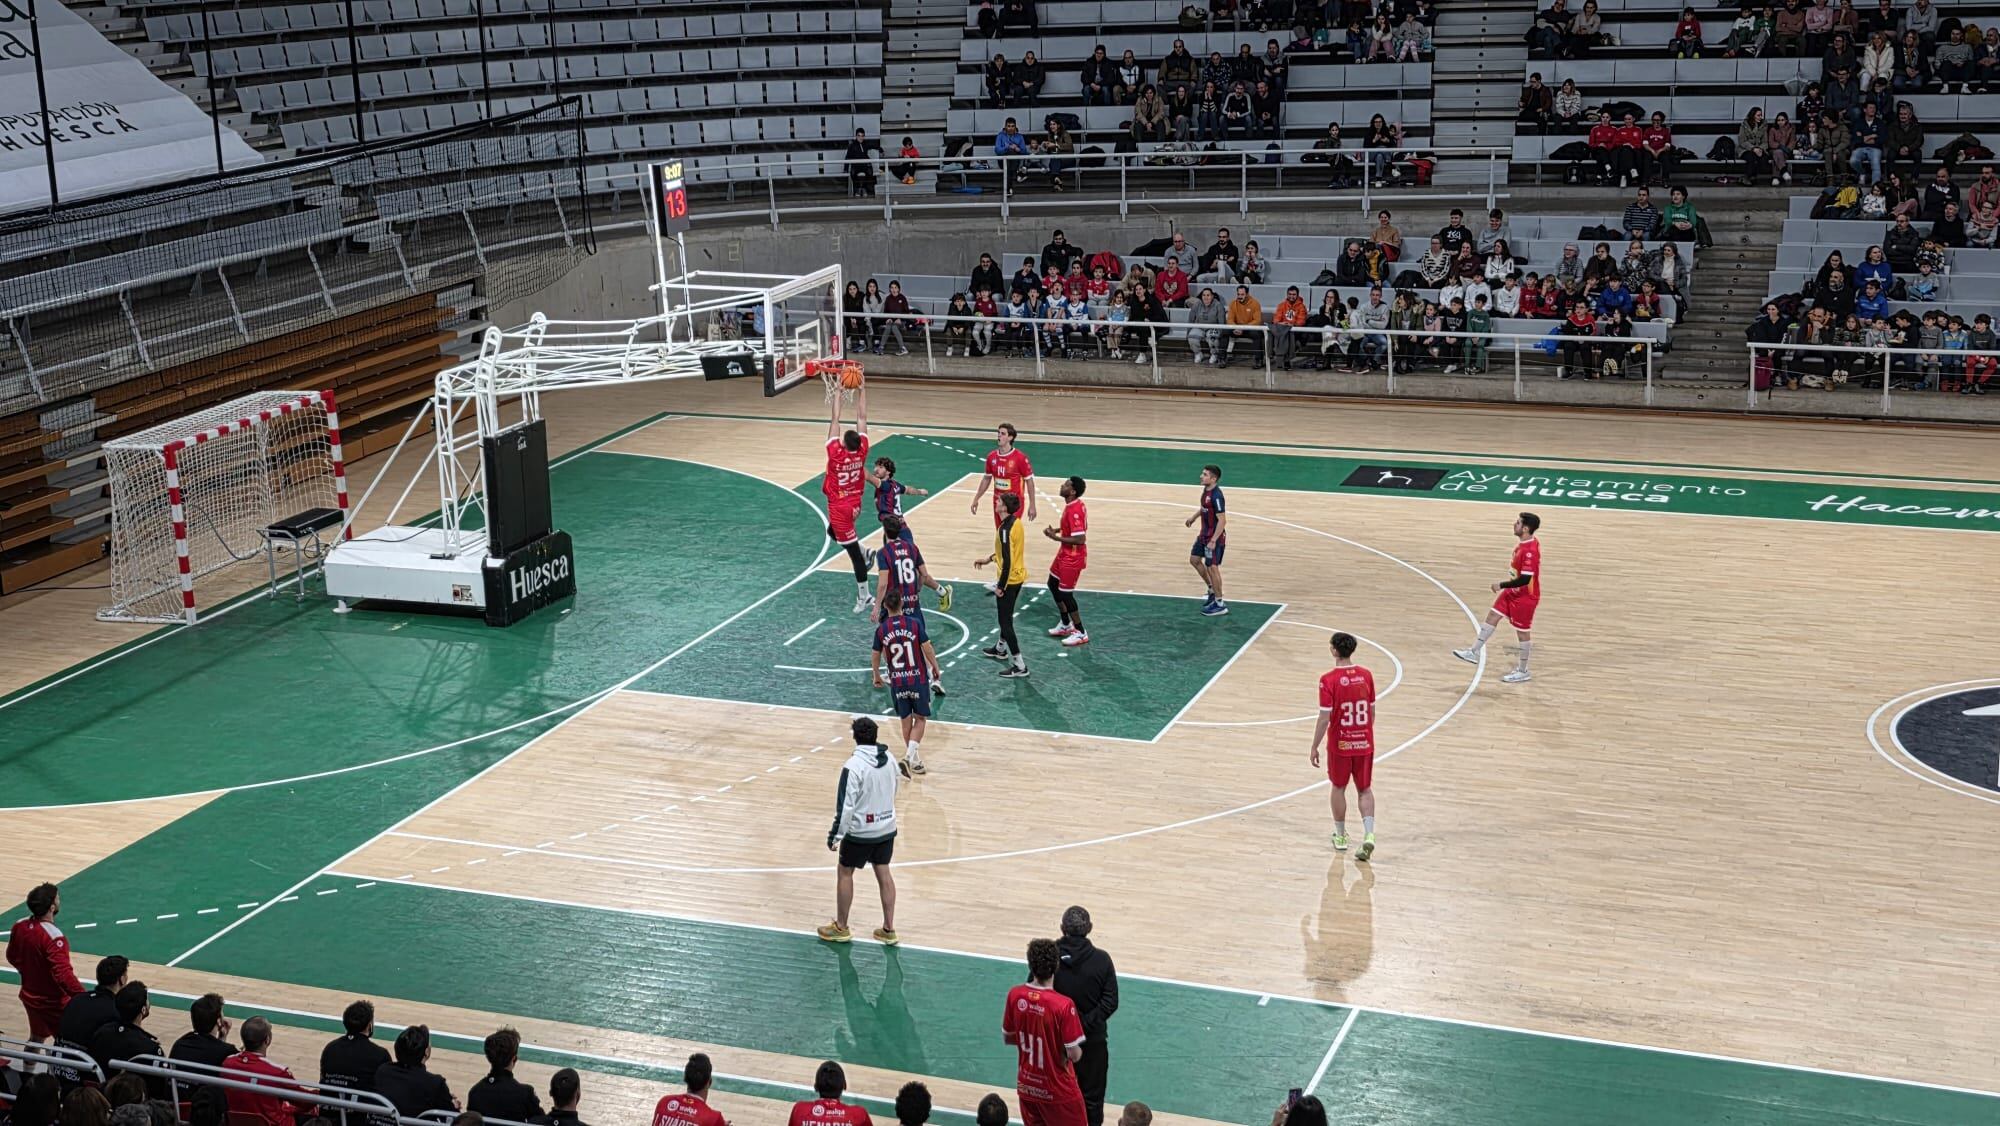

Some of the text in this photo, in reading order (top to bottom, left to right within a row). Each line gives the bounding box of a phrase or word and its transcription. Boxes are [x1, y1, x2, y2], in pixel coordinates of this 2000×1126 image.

[0, 118, 139, 151] HUESCA
[667, 190, 685, 218] 13
[837, 470, 861, 486] 22
[1447, 470, 1747, 497] Ayuntamiento
[1439, 480, 1670, 504] de Huesca
[509, 554, 569, 604] Huesca
[894, 558, 916, 585] 18
[890, 641, 916, 669] 21
[1340, 700, 1369, 727] 38
[1019, 1031, 1044, 1069] 41
